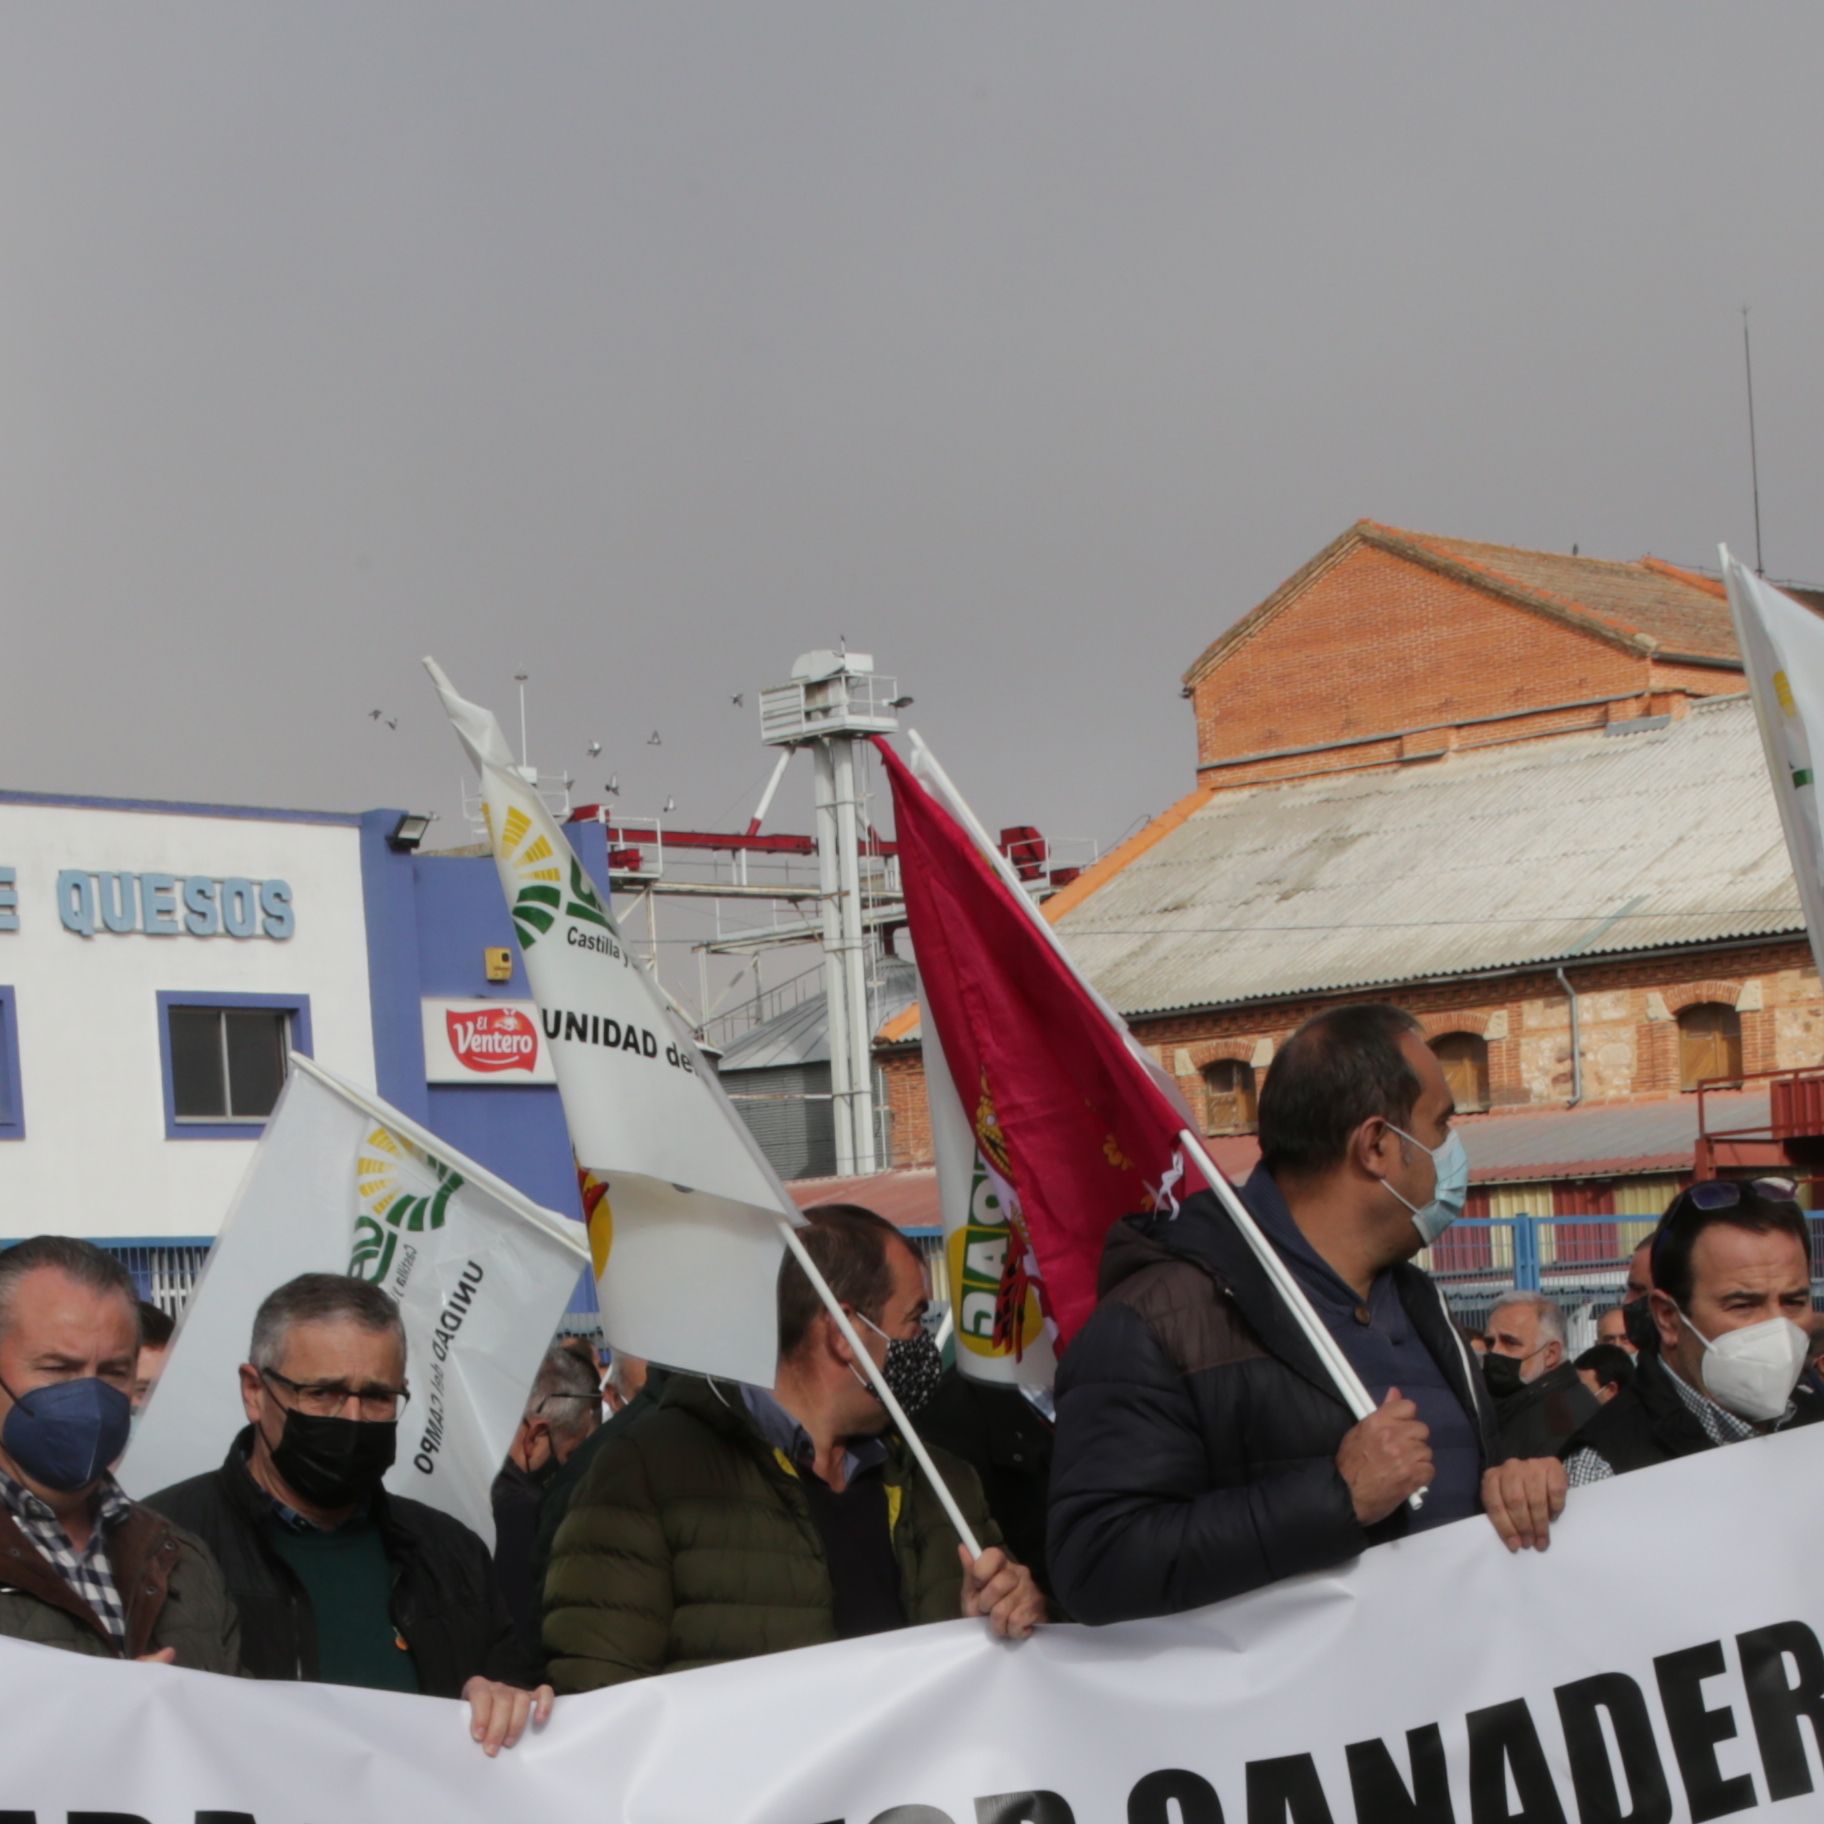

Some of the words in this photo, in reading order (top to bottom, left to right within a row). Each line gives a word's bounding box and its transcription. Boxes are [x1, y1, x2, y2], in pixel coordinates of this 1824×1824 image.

[56, 868, 296, 941] QUESOS
[567, 925, 621, 959] Castilla
[453, 1021, 534, 1054] Ventero
[475, 1016, 488, 1029] El
[542, 1008, 658, 1059] UNIDAD
